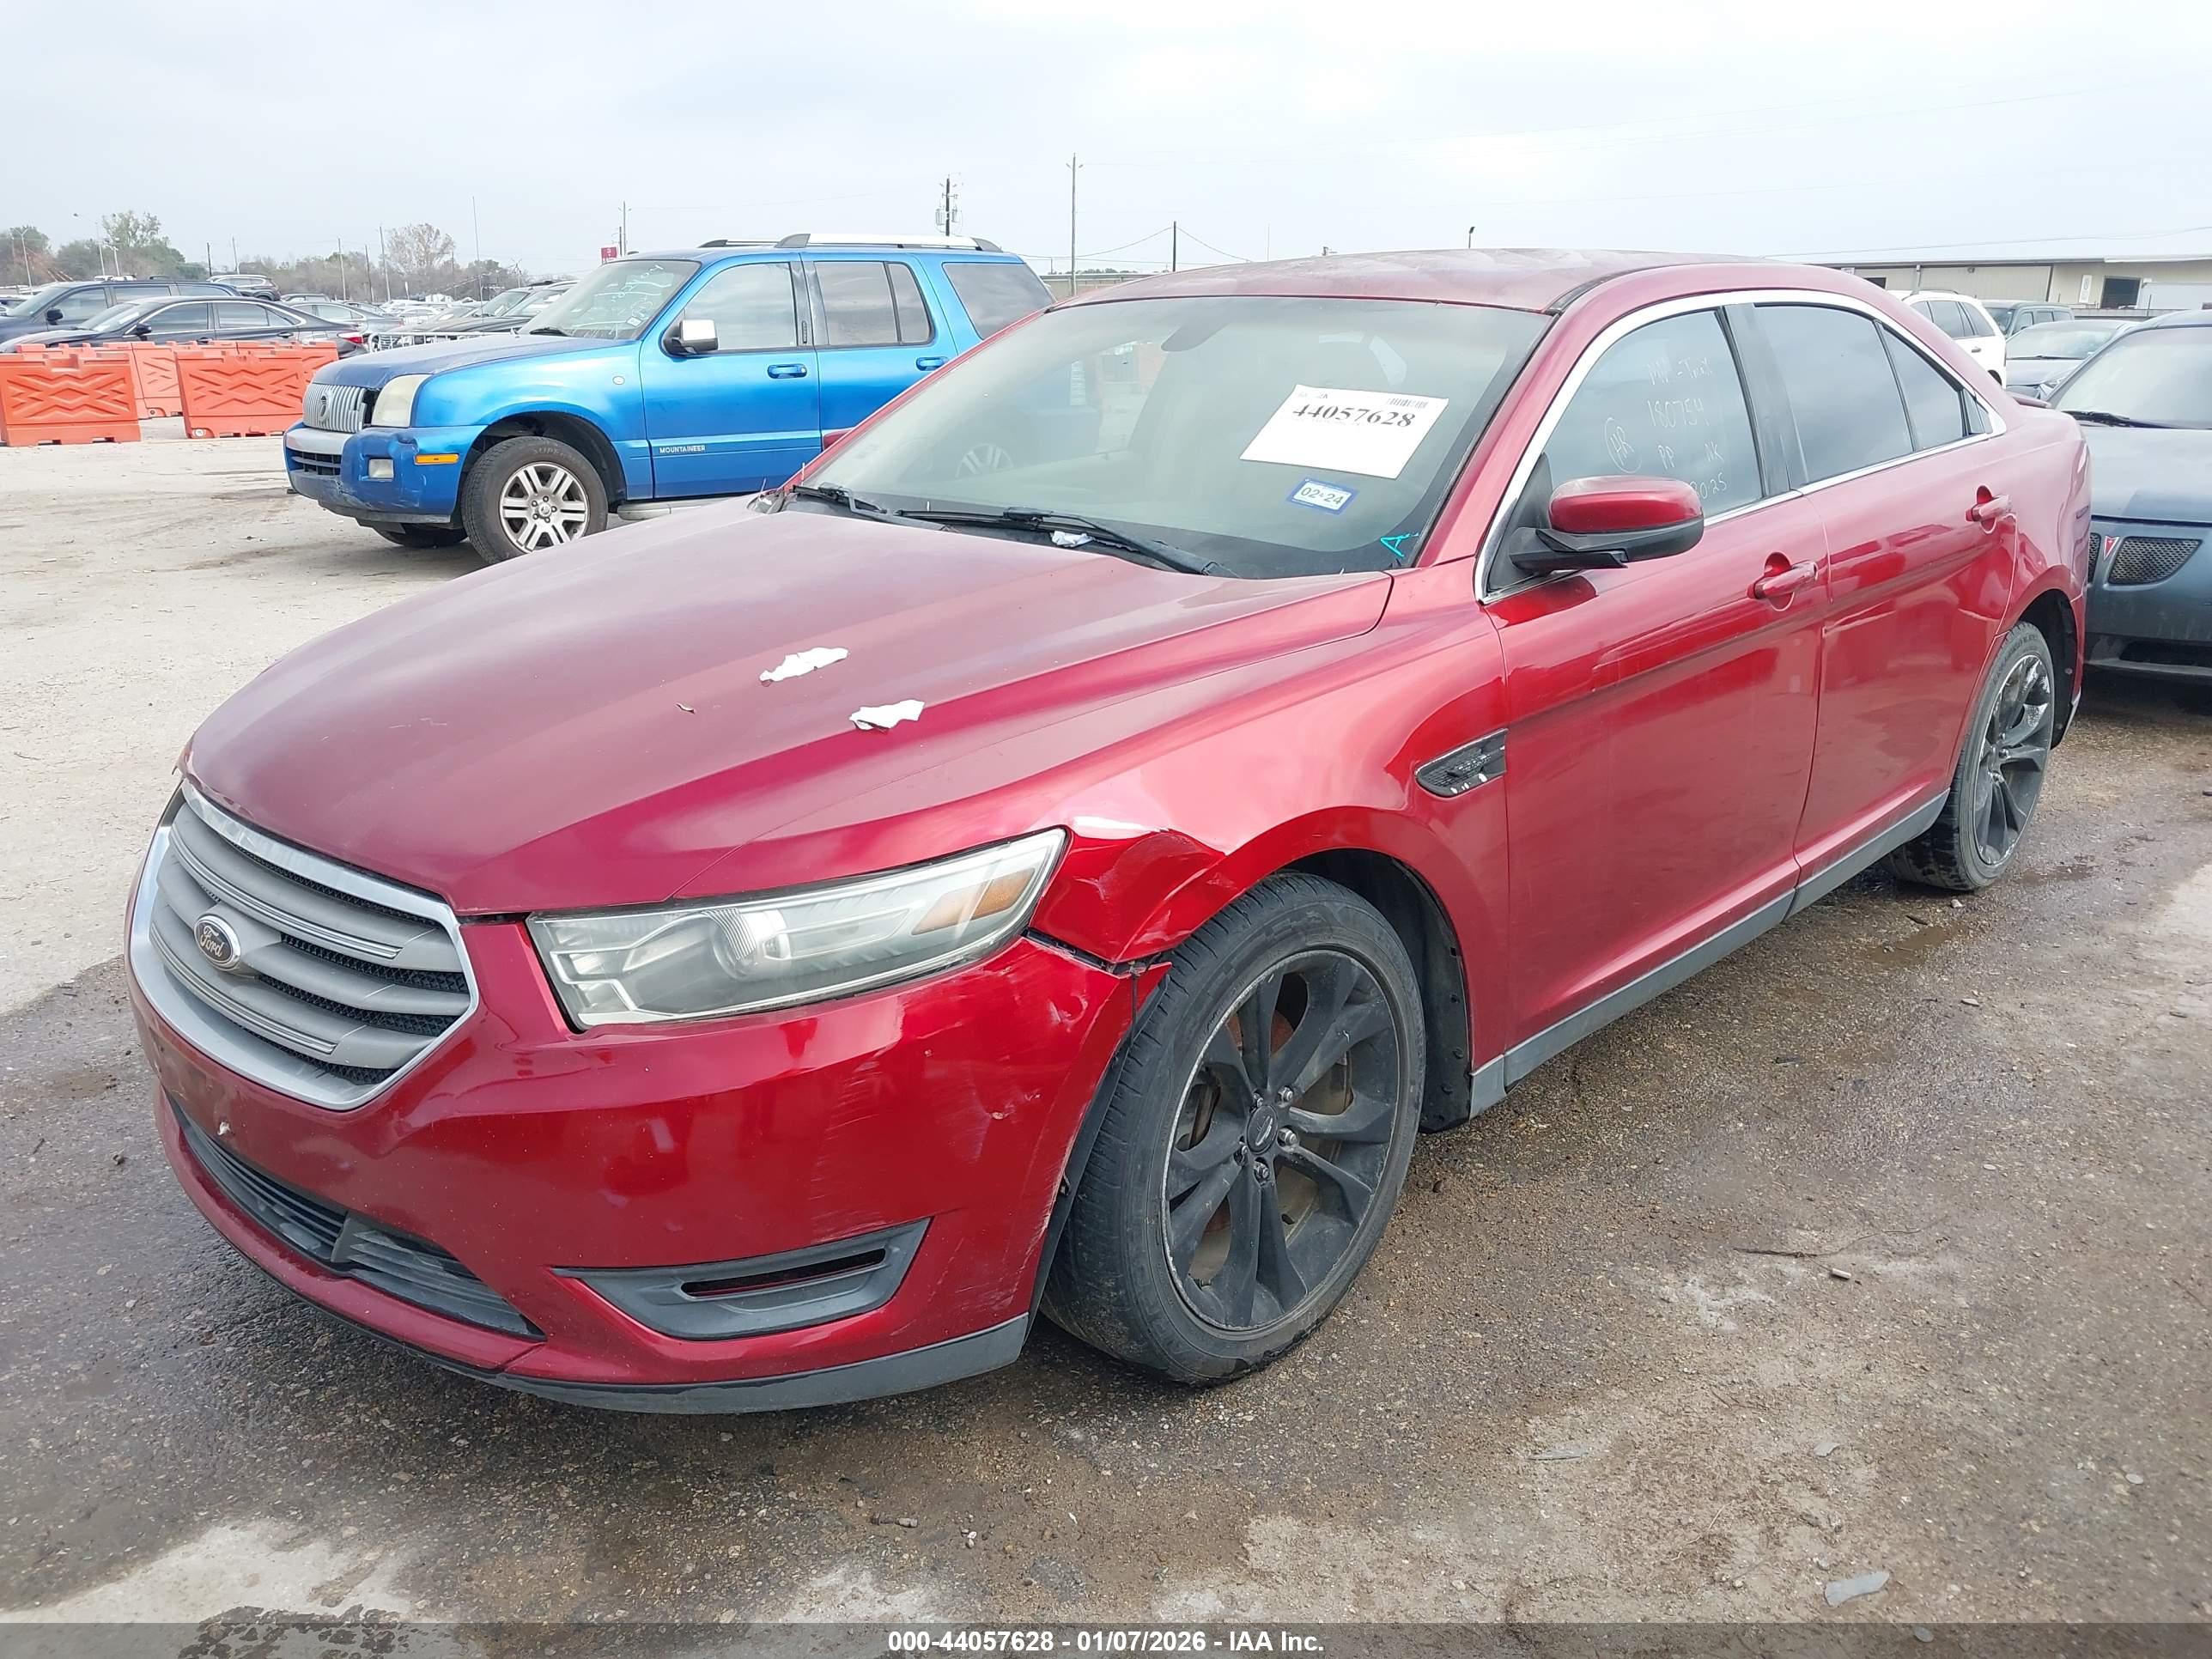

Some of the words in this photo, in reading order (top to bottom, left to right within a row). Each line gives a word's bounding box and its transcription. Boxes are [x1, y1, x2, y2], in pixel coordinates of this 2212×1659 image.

[1292, 404, 1416, 428] 44057628
[659, 445, 706, 454] MOUNTAINEER
[200, 925, 225, 957] Ford
